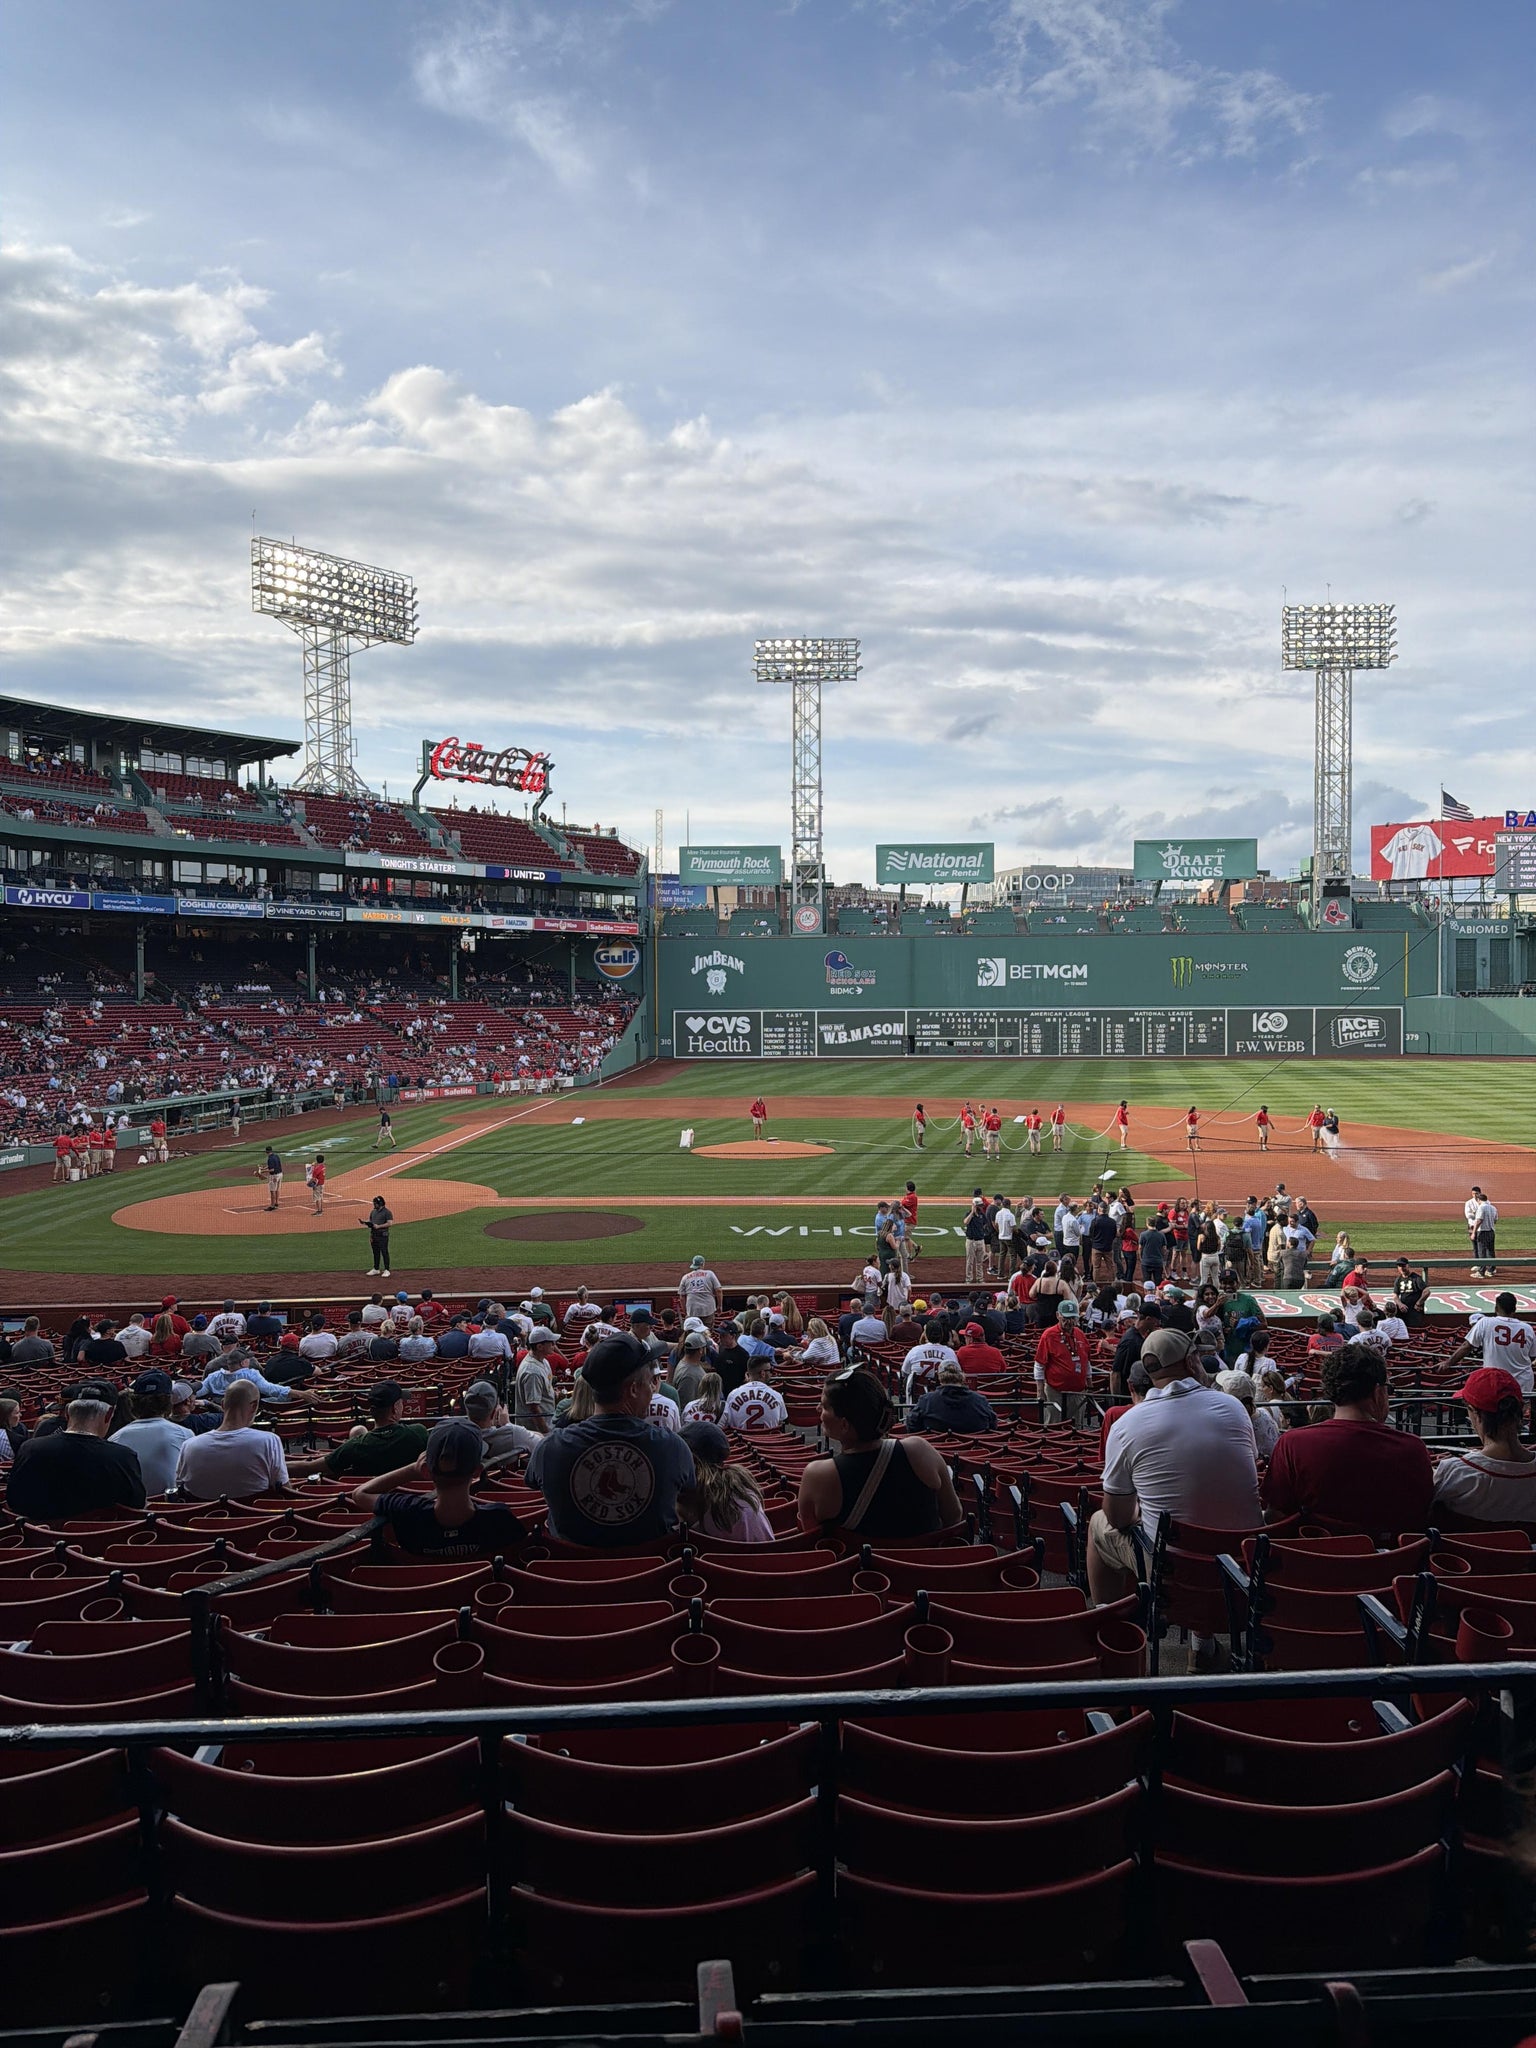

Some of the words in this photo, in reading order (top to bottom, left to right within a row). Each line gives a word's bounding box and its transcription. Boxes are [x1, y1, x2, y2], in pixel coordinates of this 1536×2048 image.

[431, 736, 551, 792] Coca-Cola
[381, 858, 418, 869] TONIGHT'S
[419, 862, 457, 872] STARTERS
[690, 857, 740, 870] Plymouth
[743, 857, 771, 868] Rock
[1163, 855, 1225, 869] DRAFT
[513, 870, 546, 880] UNITED
[1170, 867, 1224, 877] KINGS
[995, 873, 1075, 892] WHOOP
[36, 892, 72, 905] HYCU
[180, 900, 216, 909] COGHLIN
[216, 902, 263, 911] COMPANIES
[275, 907, 316, 915] VINEYARD
[416, 914, 425, 922] VS
[506, 919, 528, 927] AMAZING
[590, 923, 614, 931] Safelite
[1458, 925, 1508, 934] ABIOMED
[595, 950, 637, 964] Gulf
[1344, 946, 1364, 958] IBEW
[691, 955, 713, 975] JIM
[713, 951, 745, 974] BEAM
[1195, 962, 1249, 972] MONSTER
[831, 970, 852, 978] RED
[854, 970, 876, 978] SOX
[1010, 964, 1088, 979] BETMGM
[706, 1016, 751, 1034] CVS
[818, 1023, 833, 1031] WHO
[833, 1023, 845, 1031] BUT
[1252, 1011, 1288, 1033] 160
[1341, 1017, 1380, 1032] ACE
[1342, 1030, 1380, 1040] TICKET
[1405, 1033, 1419, 1041] 379
[688, 1036, 751, 1053] Health
[1235, 1041, 1260, 1053] F.W.
[1264, 1041, 1306, 1053] WEBB
[444, 1088, 473, 1096] Safelite
[1494, 1325, 1527, 1348] 34
[923, 1350, 945, 1360] TOLLE
[730, 1390, 780, 1412] BOGAERTS
[403, 1405, 421, 1414] 34
[746, 1404, 764, 1429] 2
[582, 1446, 644, 1471] BOSTON
[580, 1494, 610, 1519] RED
[616, 1493, 645, 1519] SOX
